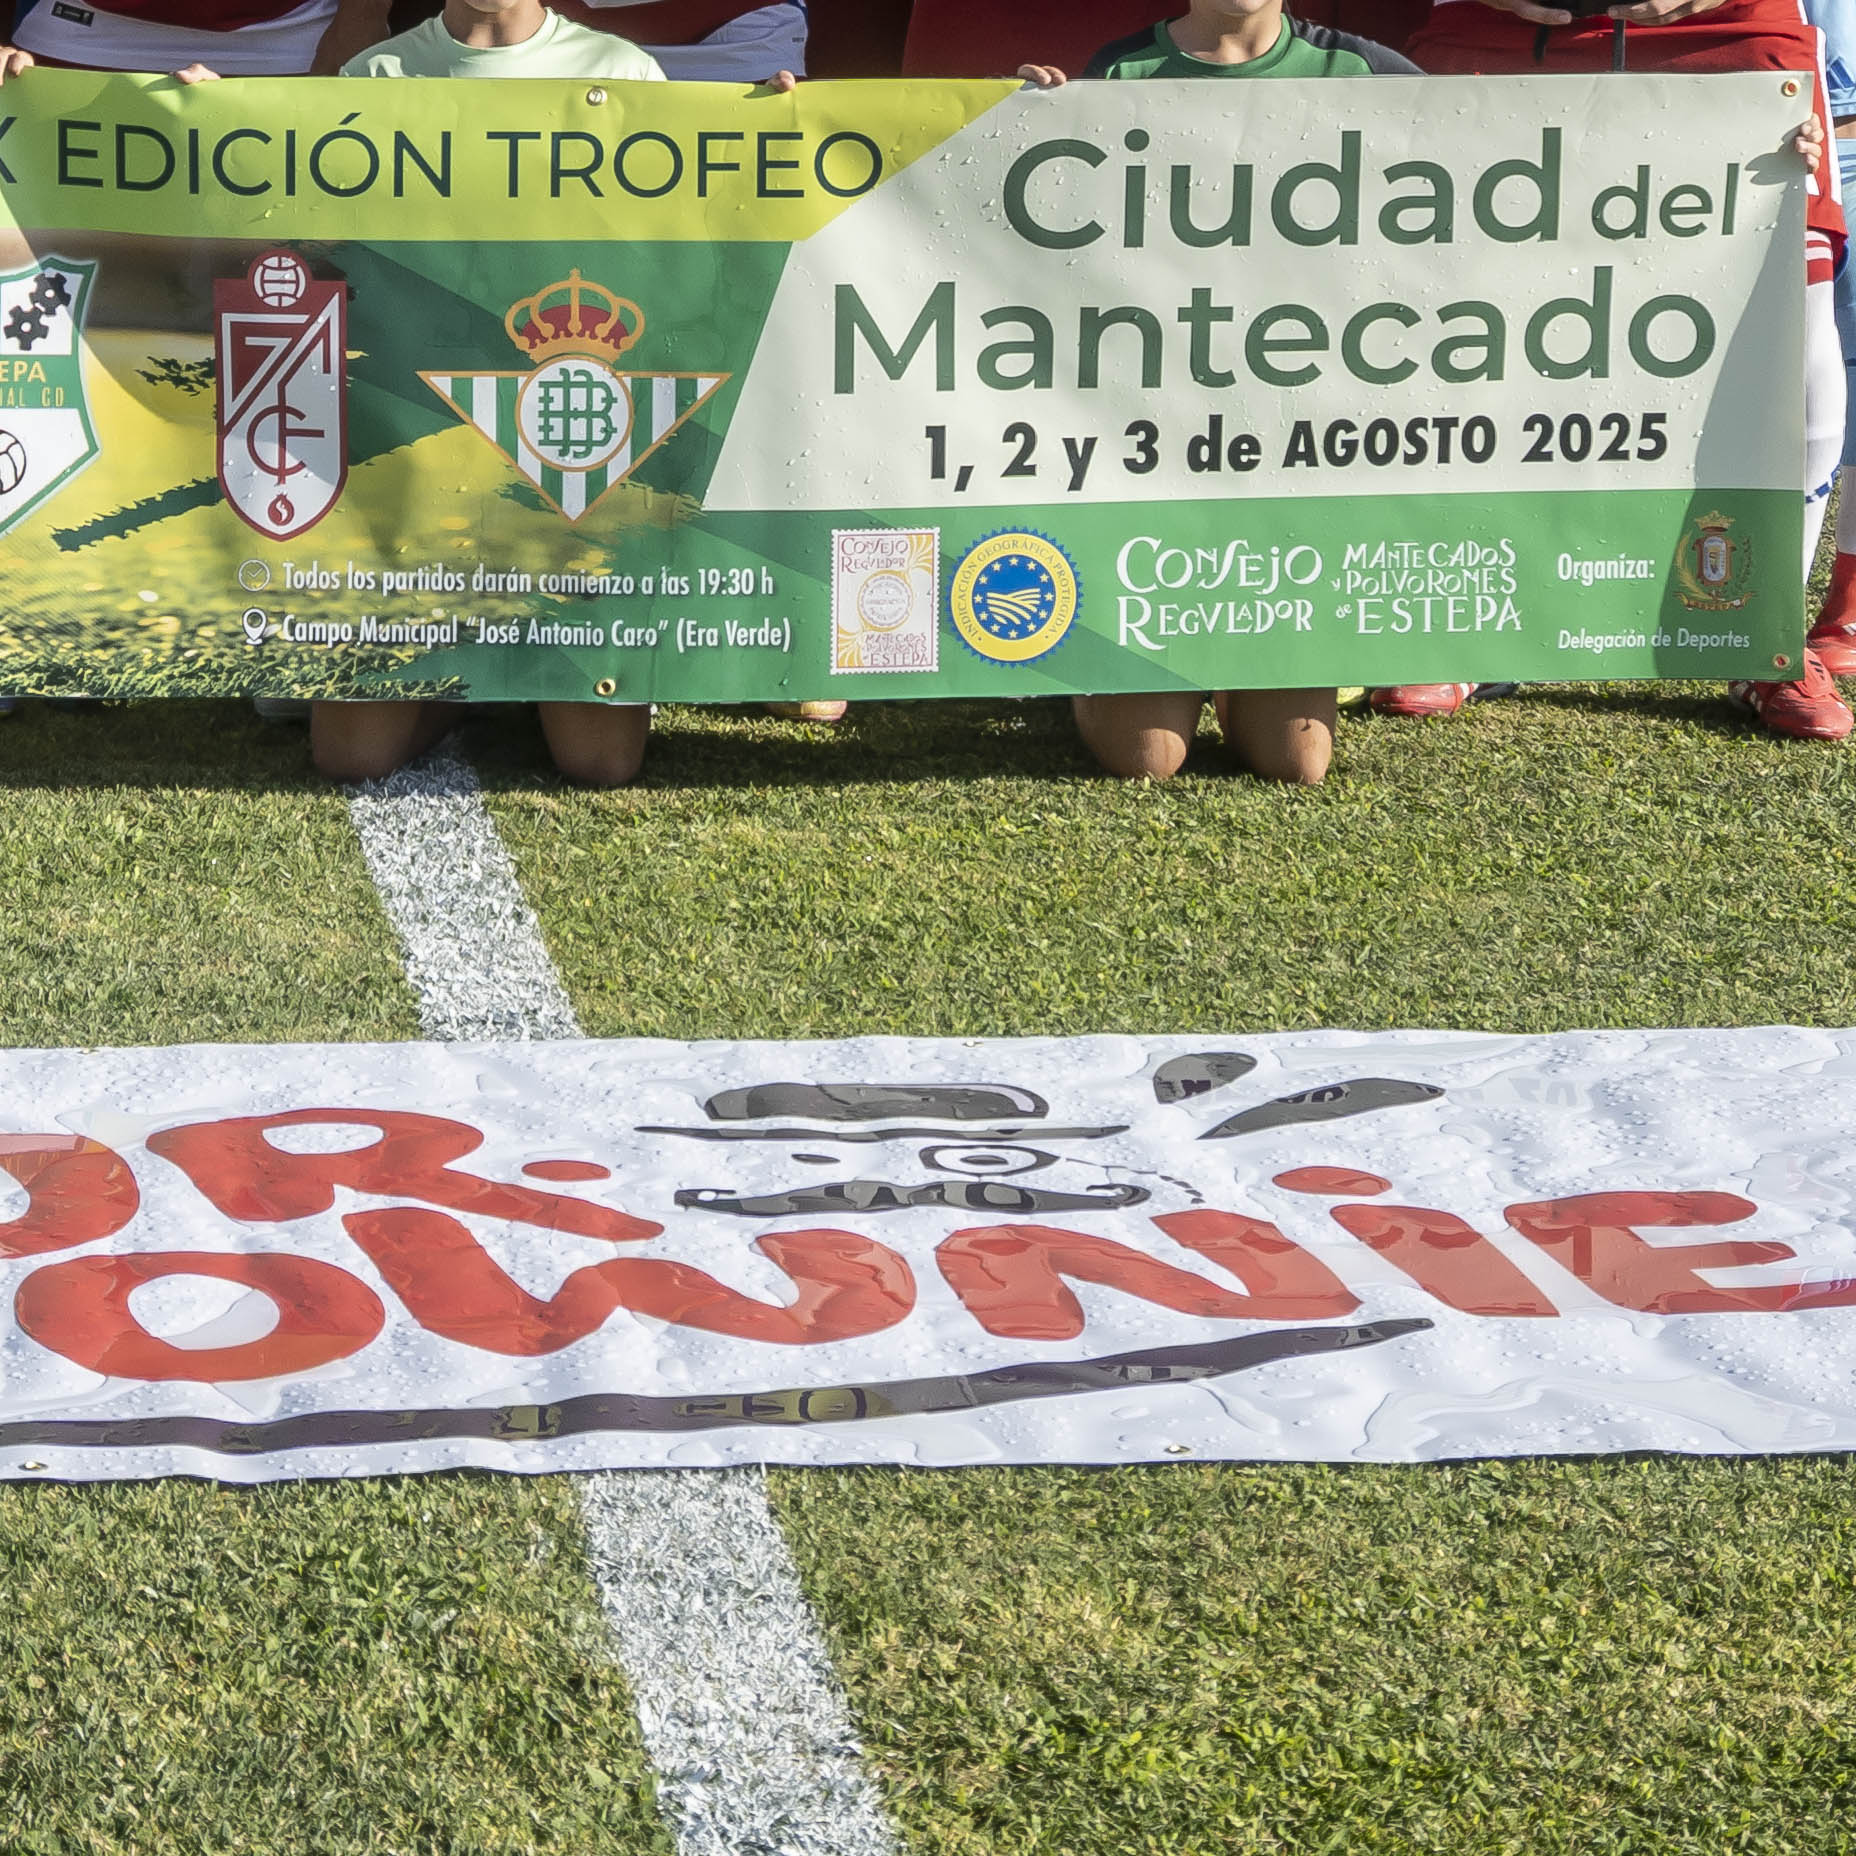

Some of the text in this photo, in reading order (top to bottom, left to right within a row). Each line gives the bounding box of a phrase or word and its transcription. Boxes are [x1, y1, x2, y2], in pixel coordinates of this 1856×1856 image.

[57, 112, 452, 198] EDICIÓN
[485, 128, 884, 200] TROFEO
[1003, 127, 1739, 250] Ciudad del
[834, 266, 1716, 396] Mantecado
[925, 412, 1669, 493] 1, 2 y 3 de AGOSTO 2025
[1116, 536, 1323, 595] CONSEJO
[1342, 538, 1517, 570] MANTECADOS
[1557, 553, 1656, 587] Organiza:
[282, 561, 774, 596] Todos los partidos darán comienzo a las 19:30 h
[959, 562, 979, 638] INDICACIÓN
[976, 538, 1056, 564] GEOGRÁFICA
[1346, 568, 1518, 596] POLVORONES
[282, 614, 352, 648] Campo
[359, 615, 458, 651] Municipal
[526, 619, 604, 646] Antonio
[676, 618, 719, 654] (Era
[726, 620, 792, 654] Verde)
[1335, 596, 1524, 635] de ESTEPA
[1557, 626, 1751, 655] Delegación de Deportes
